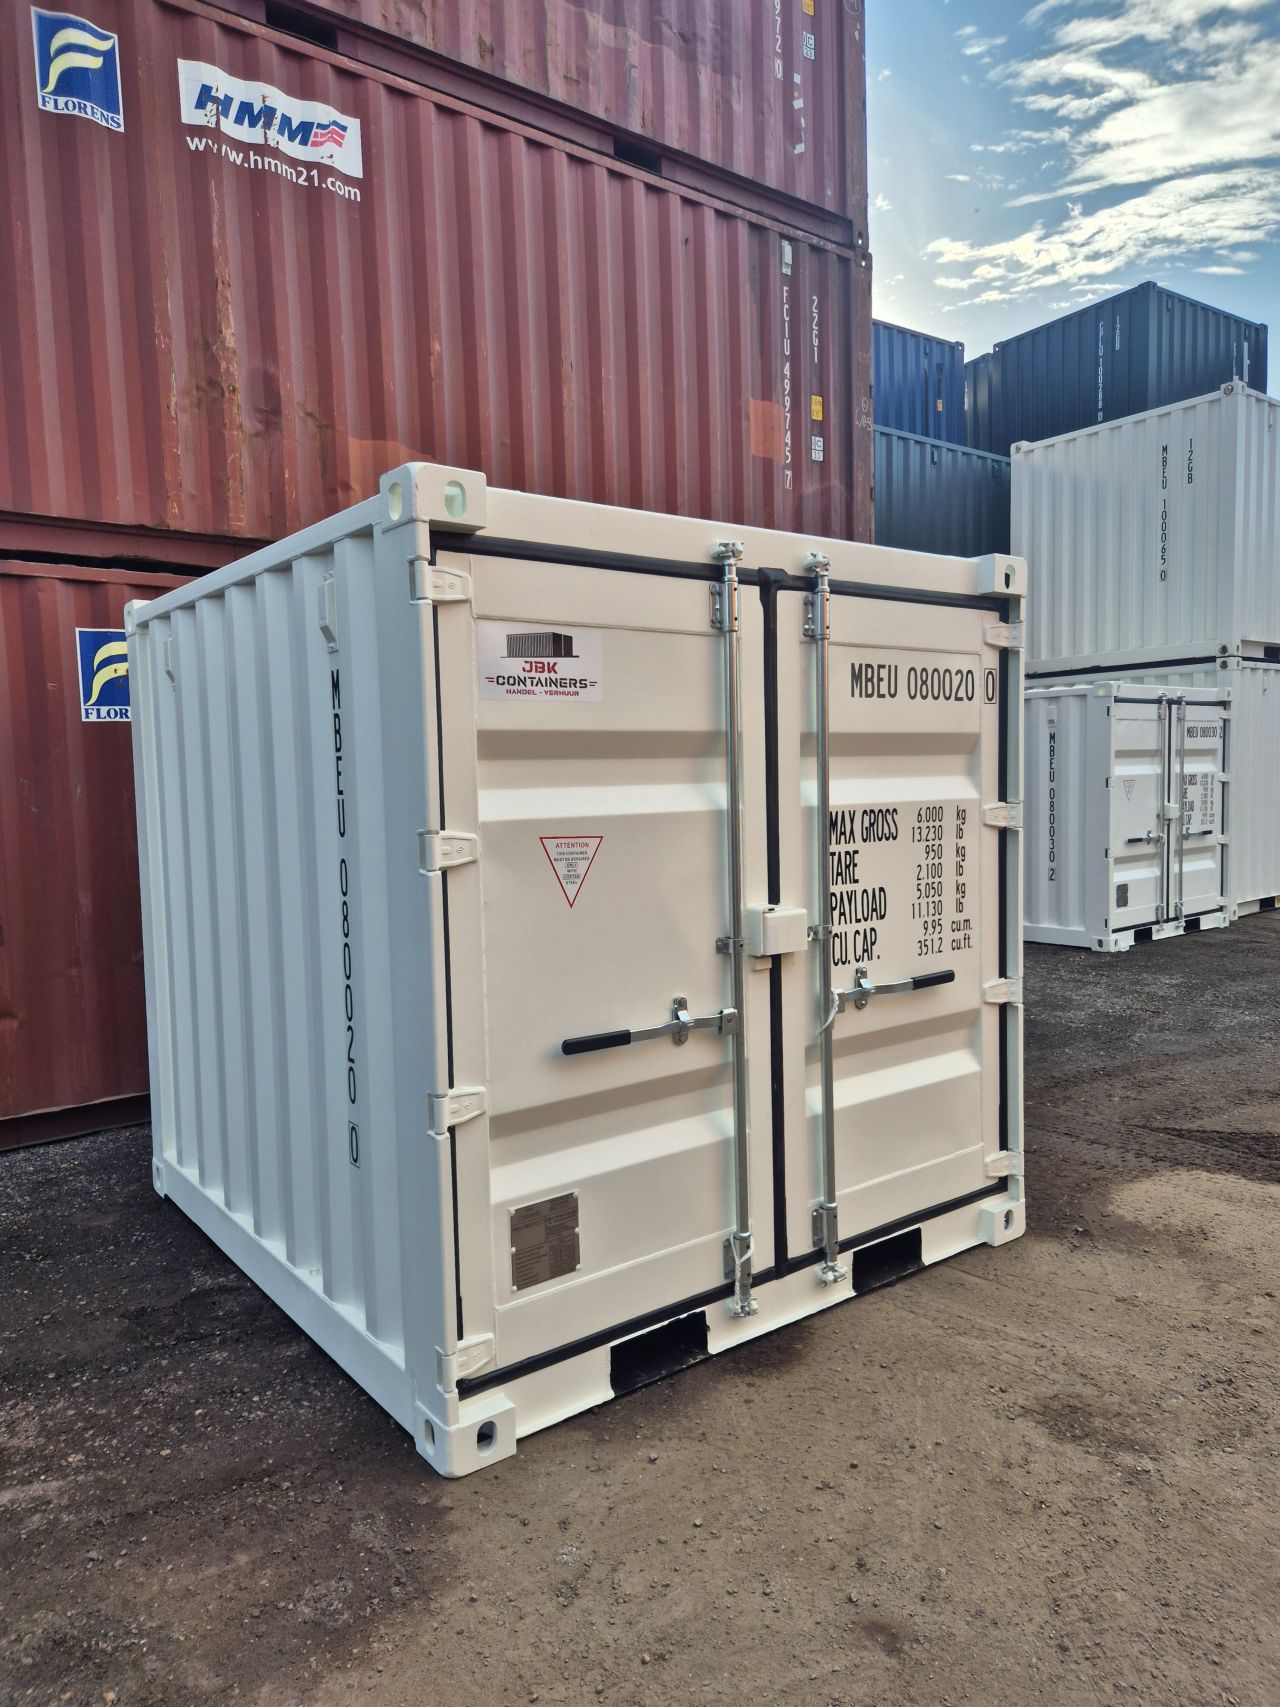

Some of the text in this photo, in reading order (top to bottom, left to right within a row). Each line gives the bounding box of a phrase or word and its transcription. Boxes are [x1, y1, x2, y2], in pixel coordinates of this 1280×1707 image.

[41, 95, 122, 129] FLORENS
[194, 83, 315, 147] HMM
[783, 362, 791, 464] 499745
[1160, 499, 1168, 566] 100065
[522, 660, 558, 674] JBK
[496, 675, 588, 689] CONTAINERS
[506, 688, 537, 696] HANDEL
[544, 689, 580, 697] VERHUUR
[851, 662, 996, 703] MBEU 080020 0
[84, 707, 130, 719] FLOR
[917, 805, 967, 825] 6.000 kg
[829, 808, 898, 846] MAX GROSS
[911, 824, 964, 843] 13.230 lb
[924, 842, 966, 862] 950 kg
[829, 850, 859, 886] TARE
[916, 861, 964, 880] 2.100 lb
[331, 670, 347, 838] MBEU
[339, 858, 356, 1106] 080020
[916, 879, 966, 900] 5.050 kg
[830, 886, 887, 926] PAYLOAD
[911, 898, 964, 919] 11.130 lb
[923, 918, 973, 936] 9.95 cu.m.
[832, 927, 881, 967] CU. CAP.
[917, 937, 944, 956] 351.2
